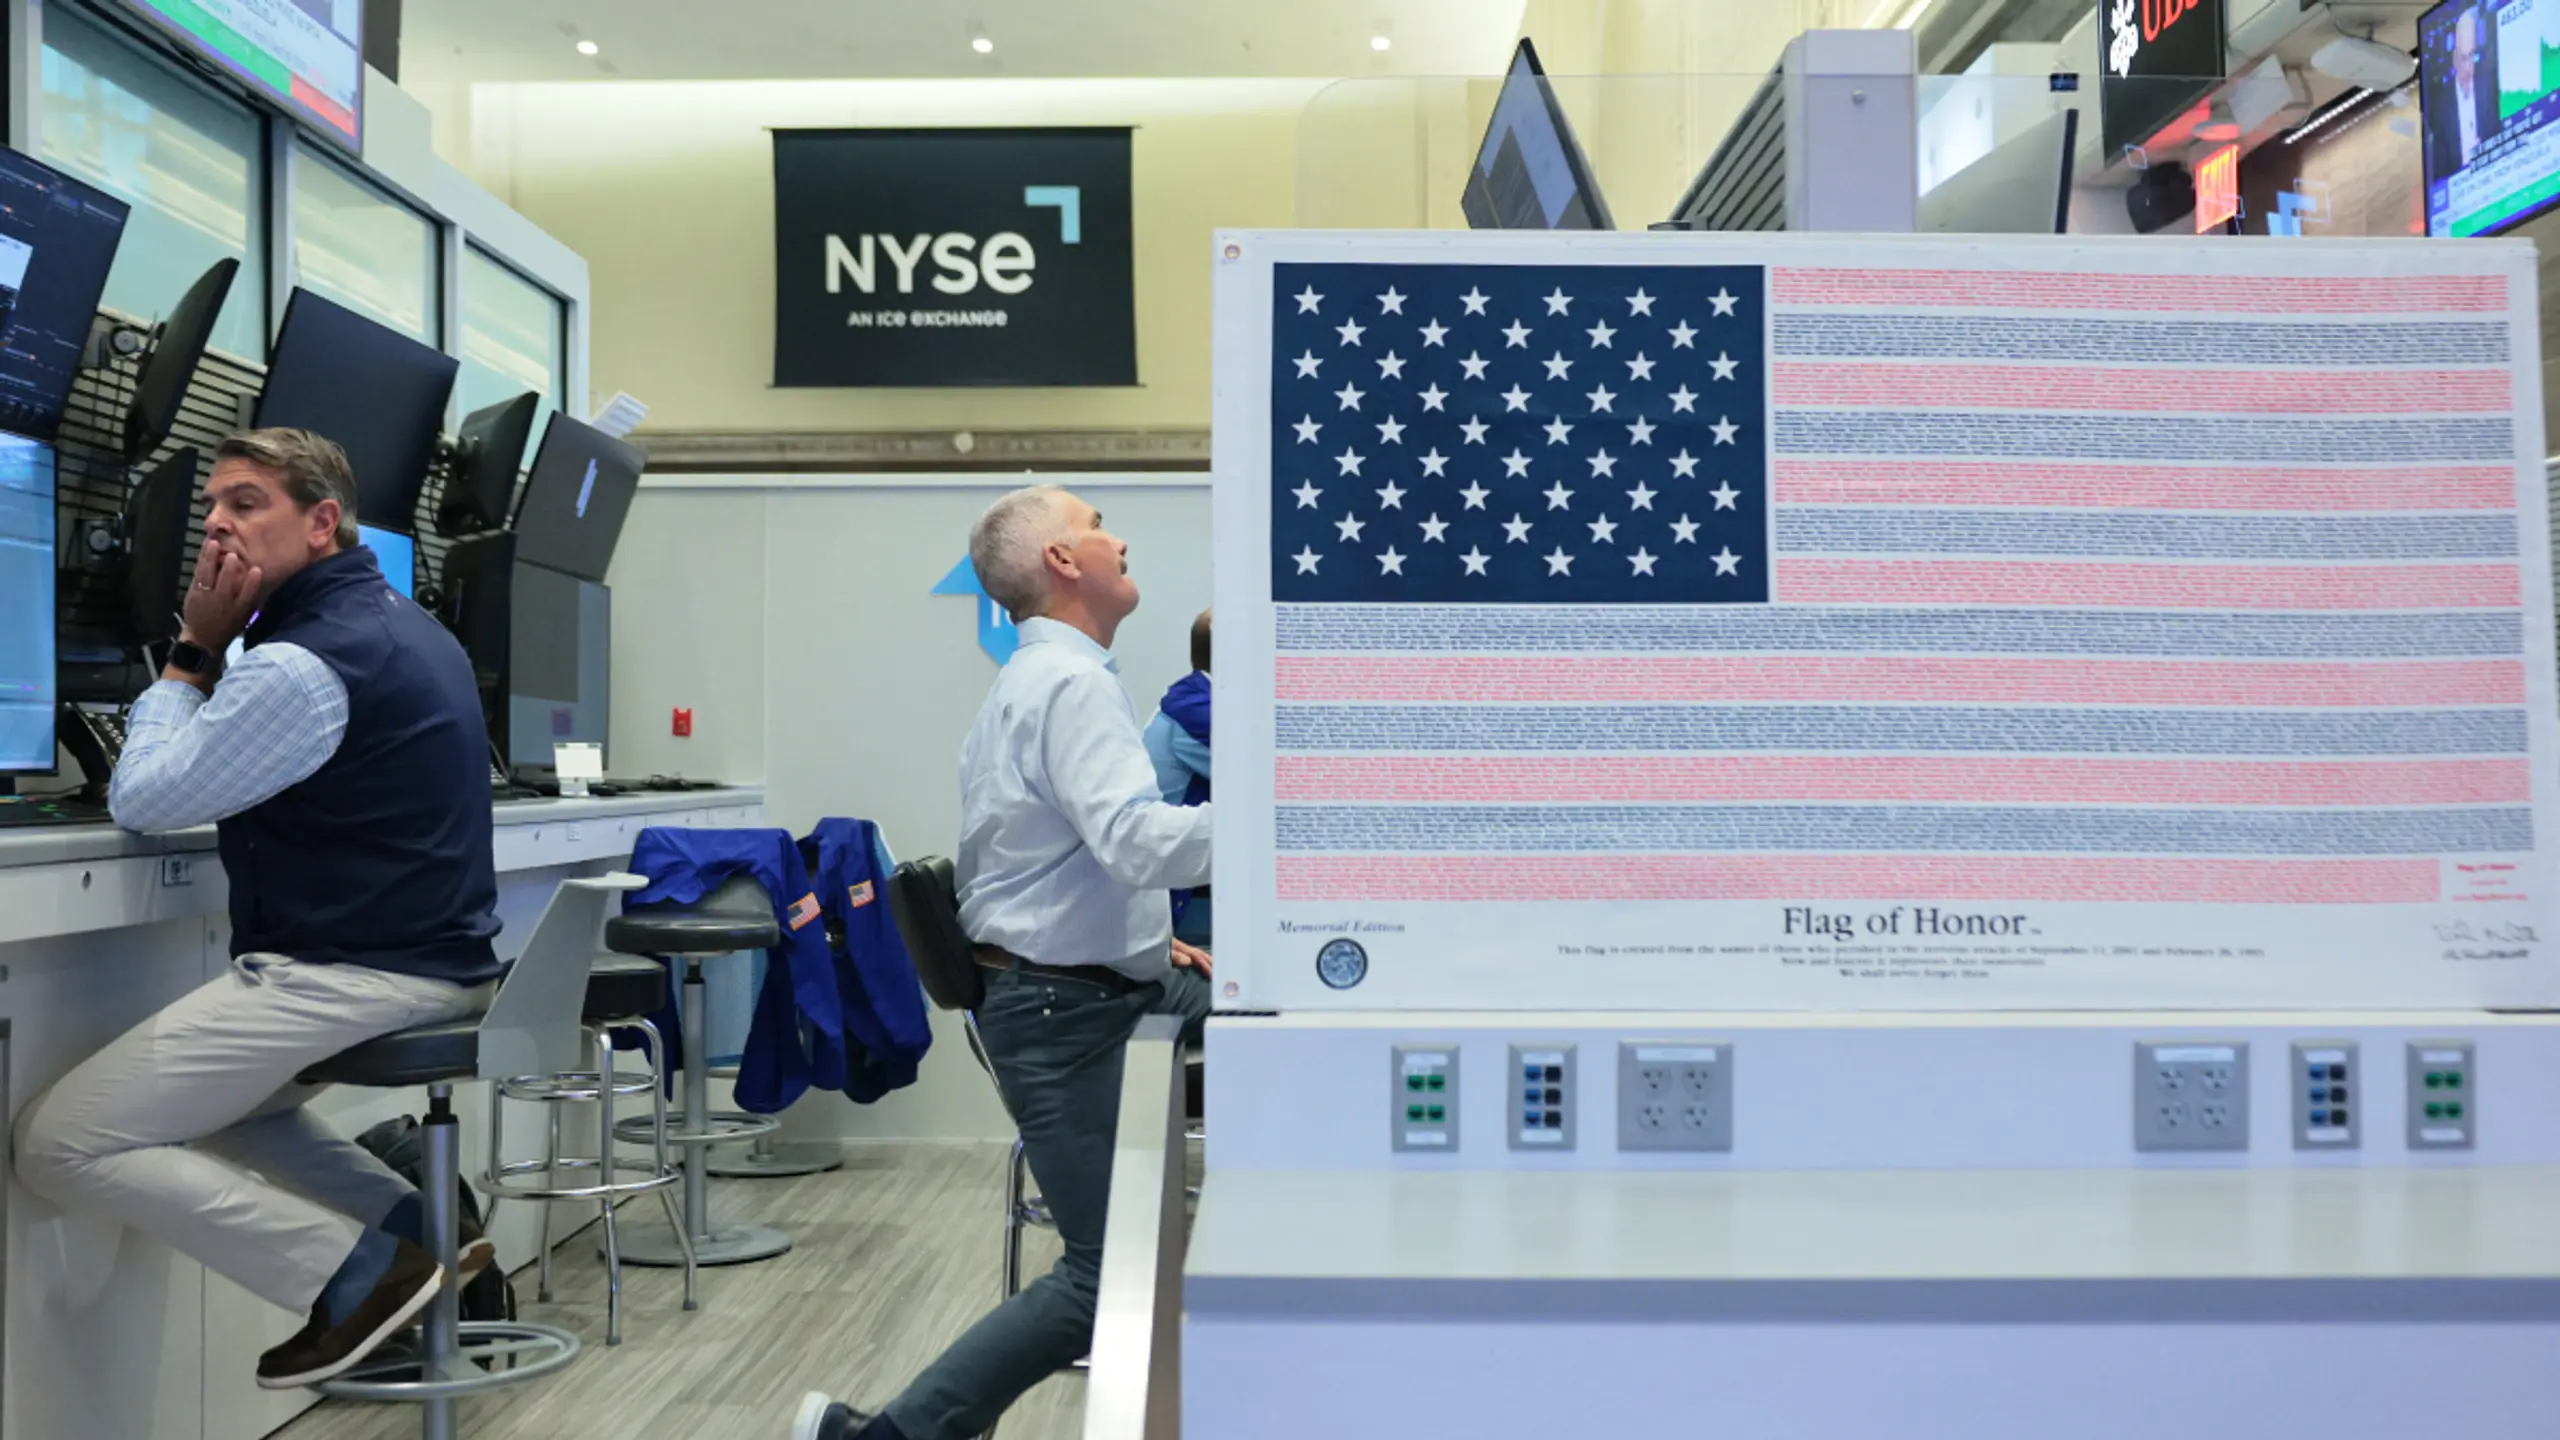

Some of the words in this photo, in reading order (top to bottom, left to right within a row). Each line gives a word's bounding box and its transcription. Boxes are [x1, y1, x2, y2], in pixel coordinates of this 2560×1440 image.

[847, 311, 874, 327] AN
[1278, 919, 1351, 934] Memorial
[1353, 920, 1406, 933] Edition
[1782, 906, 1855, 940] Flag
[1866, 906, 1905, 935] of
[1914, 907, 2027, 936] Honor
